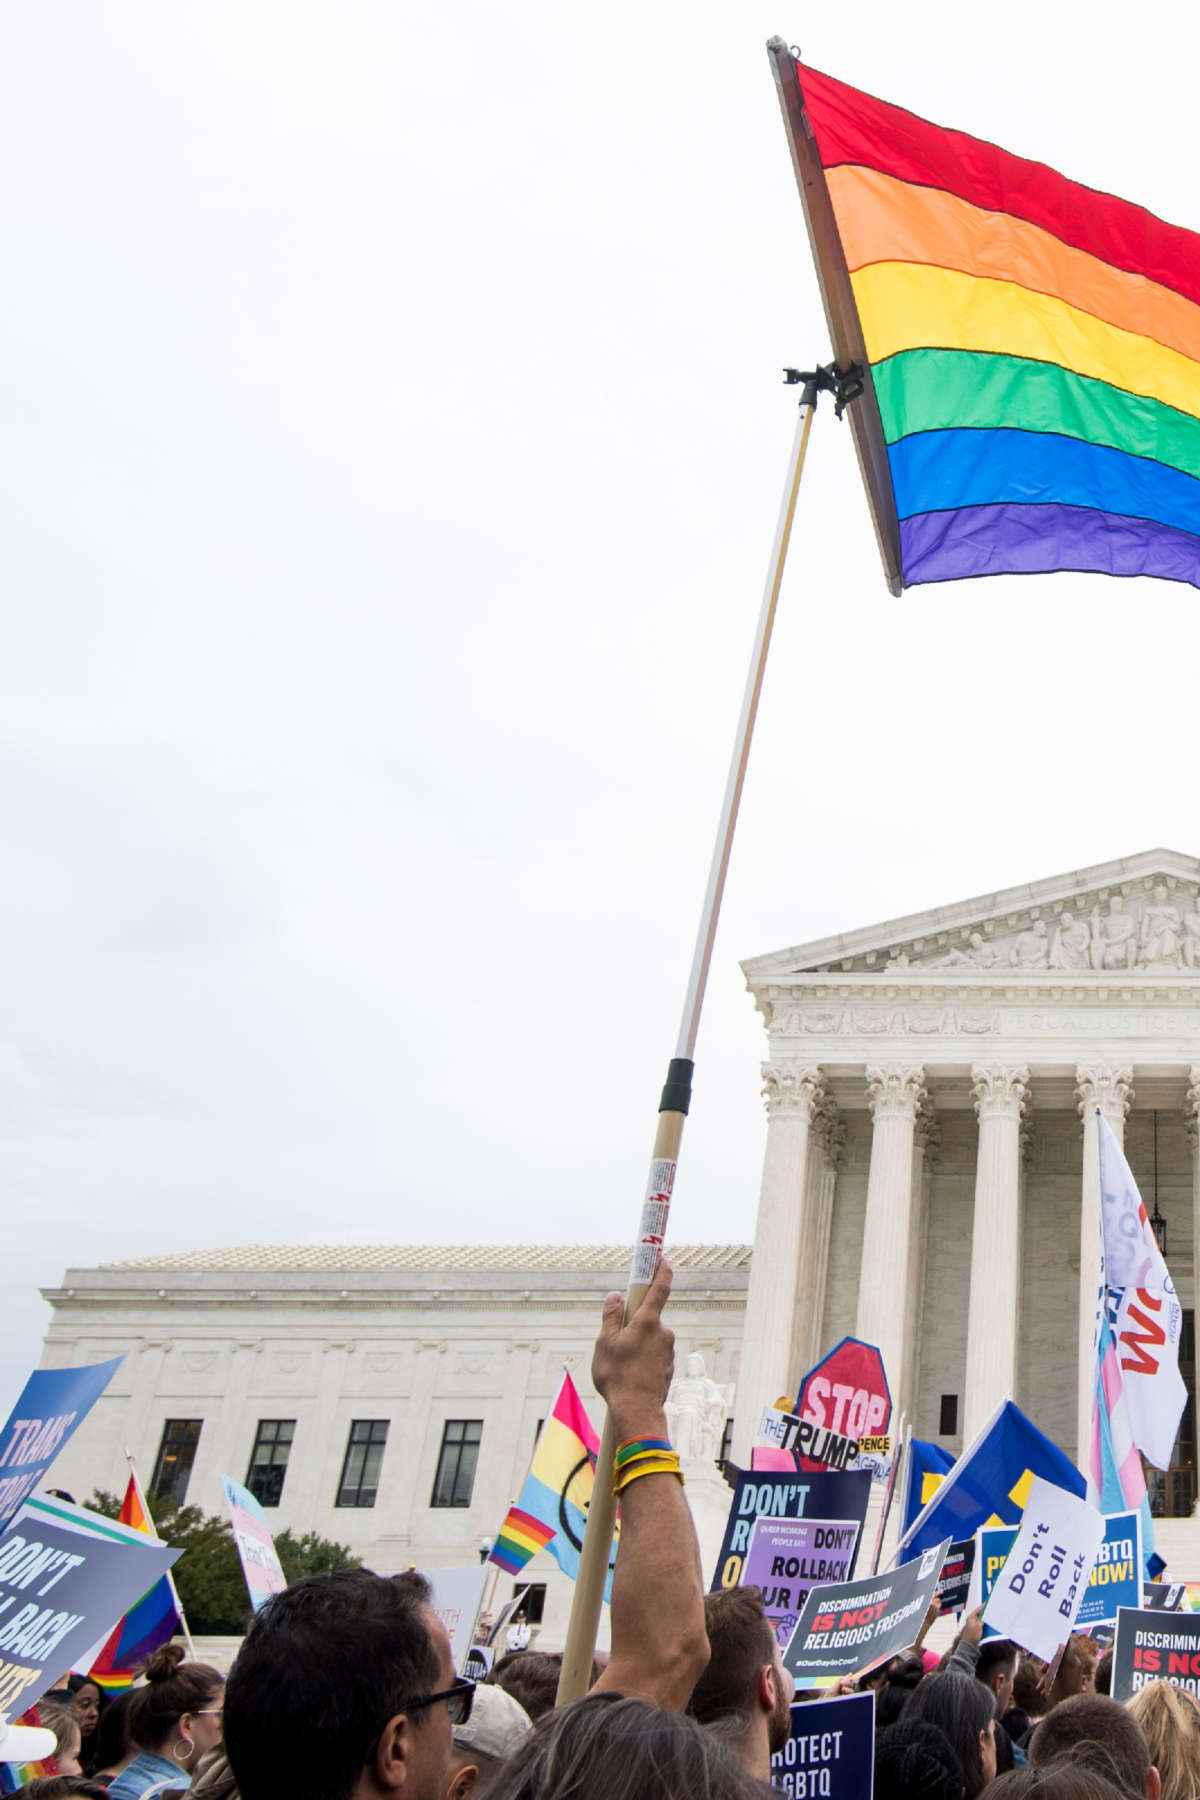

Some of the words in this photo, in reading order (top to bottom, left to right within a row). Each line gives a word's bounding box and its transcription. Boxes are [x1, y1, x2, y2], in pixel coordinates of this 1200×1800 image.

[803, 1376, 887, 1442] STOP
[764, 1418, 786, 1439] THE
[780, 1414, 860, 1471] TRUMP
[859, 1437, 890, 1451] PENCE
[738, 1484, 811, 1517] DON'T
[814, 1528, 856, 1550] DON'T
[1098, 1539, 1133, 1564] BTQ
[771, 1556, 849, 1582] ROLLBACK
[1008, 1522, 1050, 1595] Don't
[1037, 1545, 1067, 1599] Roll
[761, 1586, 791, 1609] UR
[817, 1586, 893, 1614] DISCRIMINATION
[1058, 1553, 1085, 1618] Back
[803, 1624, 875, 1650] RELIGIOUS
[874, 1594, 925, 1638] FREEDOM
[810, 1613, 836, 1632] IS
[838, 1600, 888, 1630] NOT
[1133, 1647, 1161, 1670] IS
[771, 1731, 843, 1768] ROTECT
